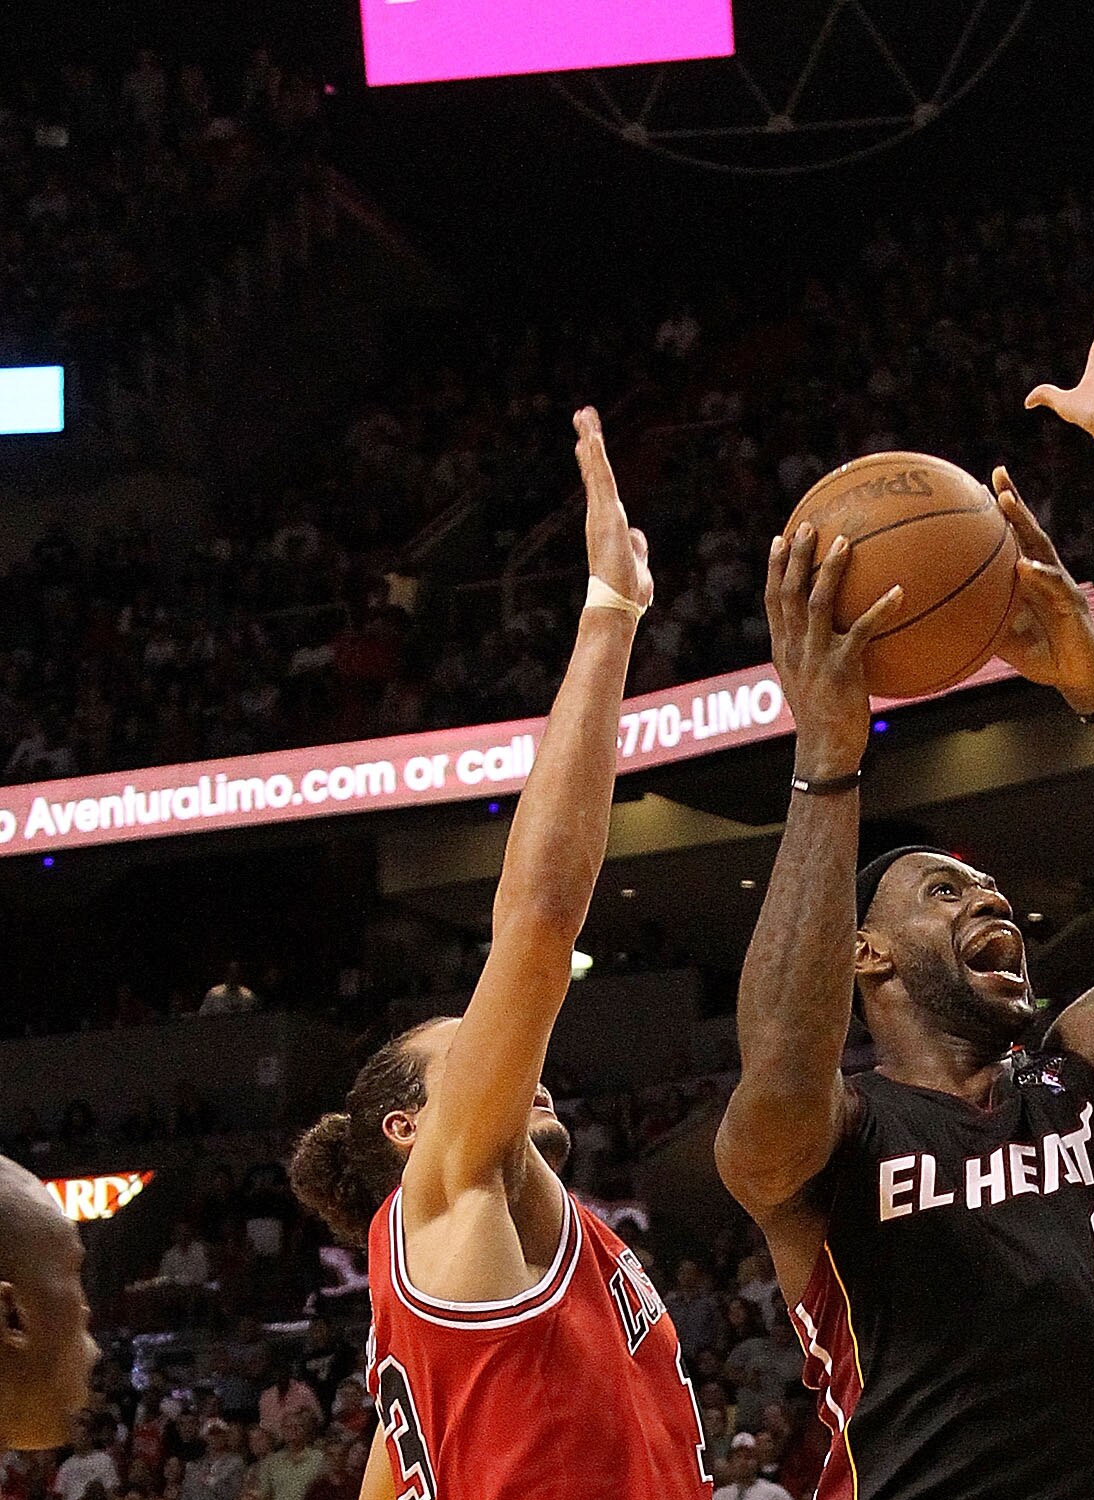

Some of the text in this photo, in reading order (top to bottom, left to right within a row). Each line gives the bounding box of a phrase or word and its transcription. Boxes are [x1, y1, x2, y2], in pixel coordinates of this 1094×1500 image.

[23, 759, 396, 840] AventuraLimo.com
[403, 753, 450, 792] or
[456, 734, 535, 783] call
[879, 1101, 1094, 1222] EL HEAT
